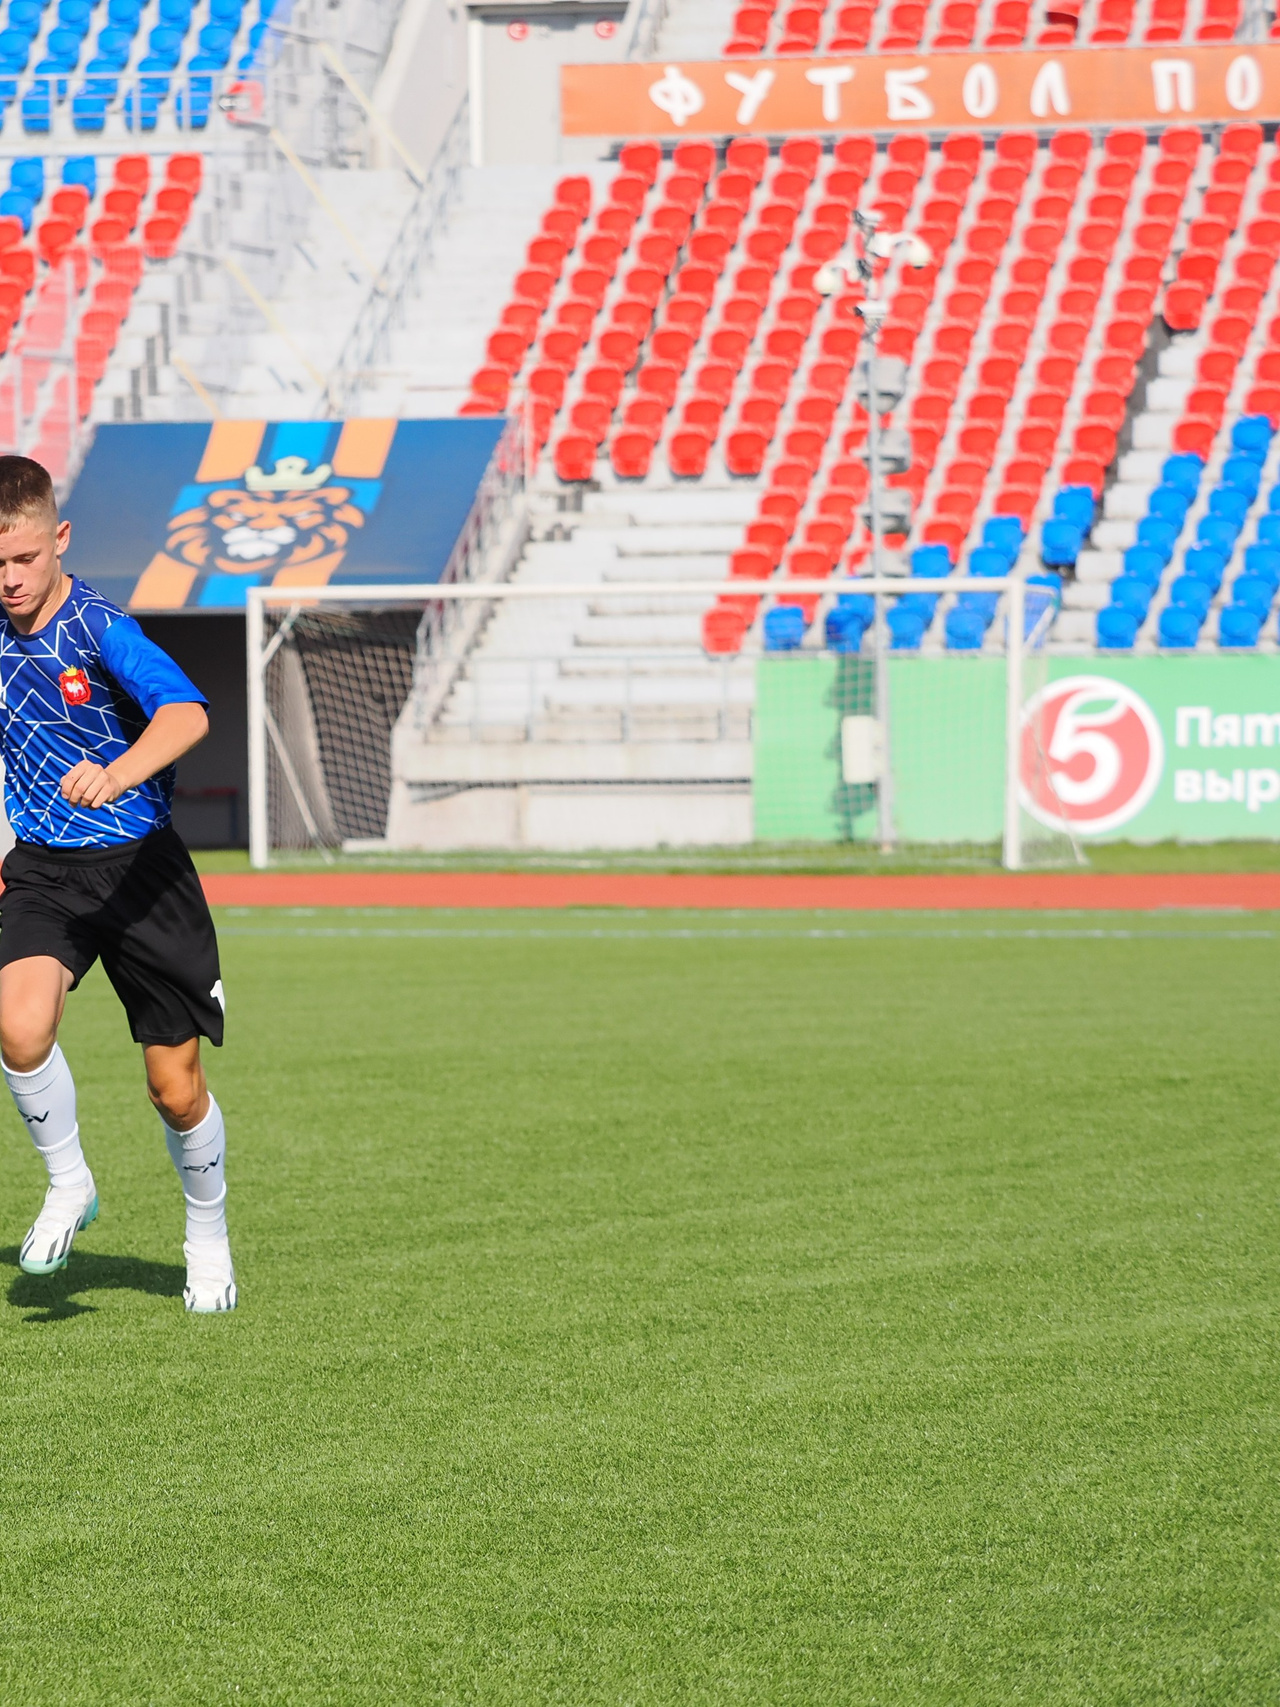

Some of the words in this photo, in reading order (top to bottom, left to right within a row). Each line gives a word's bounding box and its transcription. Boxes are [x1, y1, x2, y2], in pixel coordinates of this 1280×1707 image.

[648, 60, 1071, 126] ФУТБОЛ
[1152, 55, 1261, 114] ПО
[1048, 686, 1130, 806] 5
[1174, 768, 1280, 812] выр
